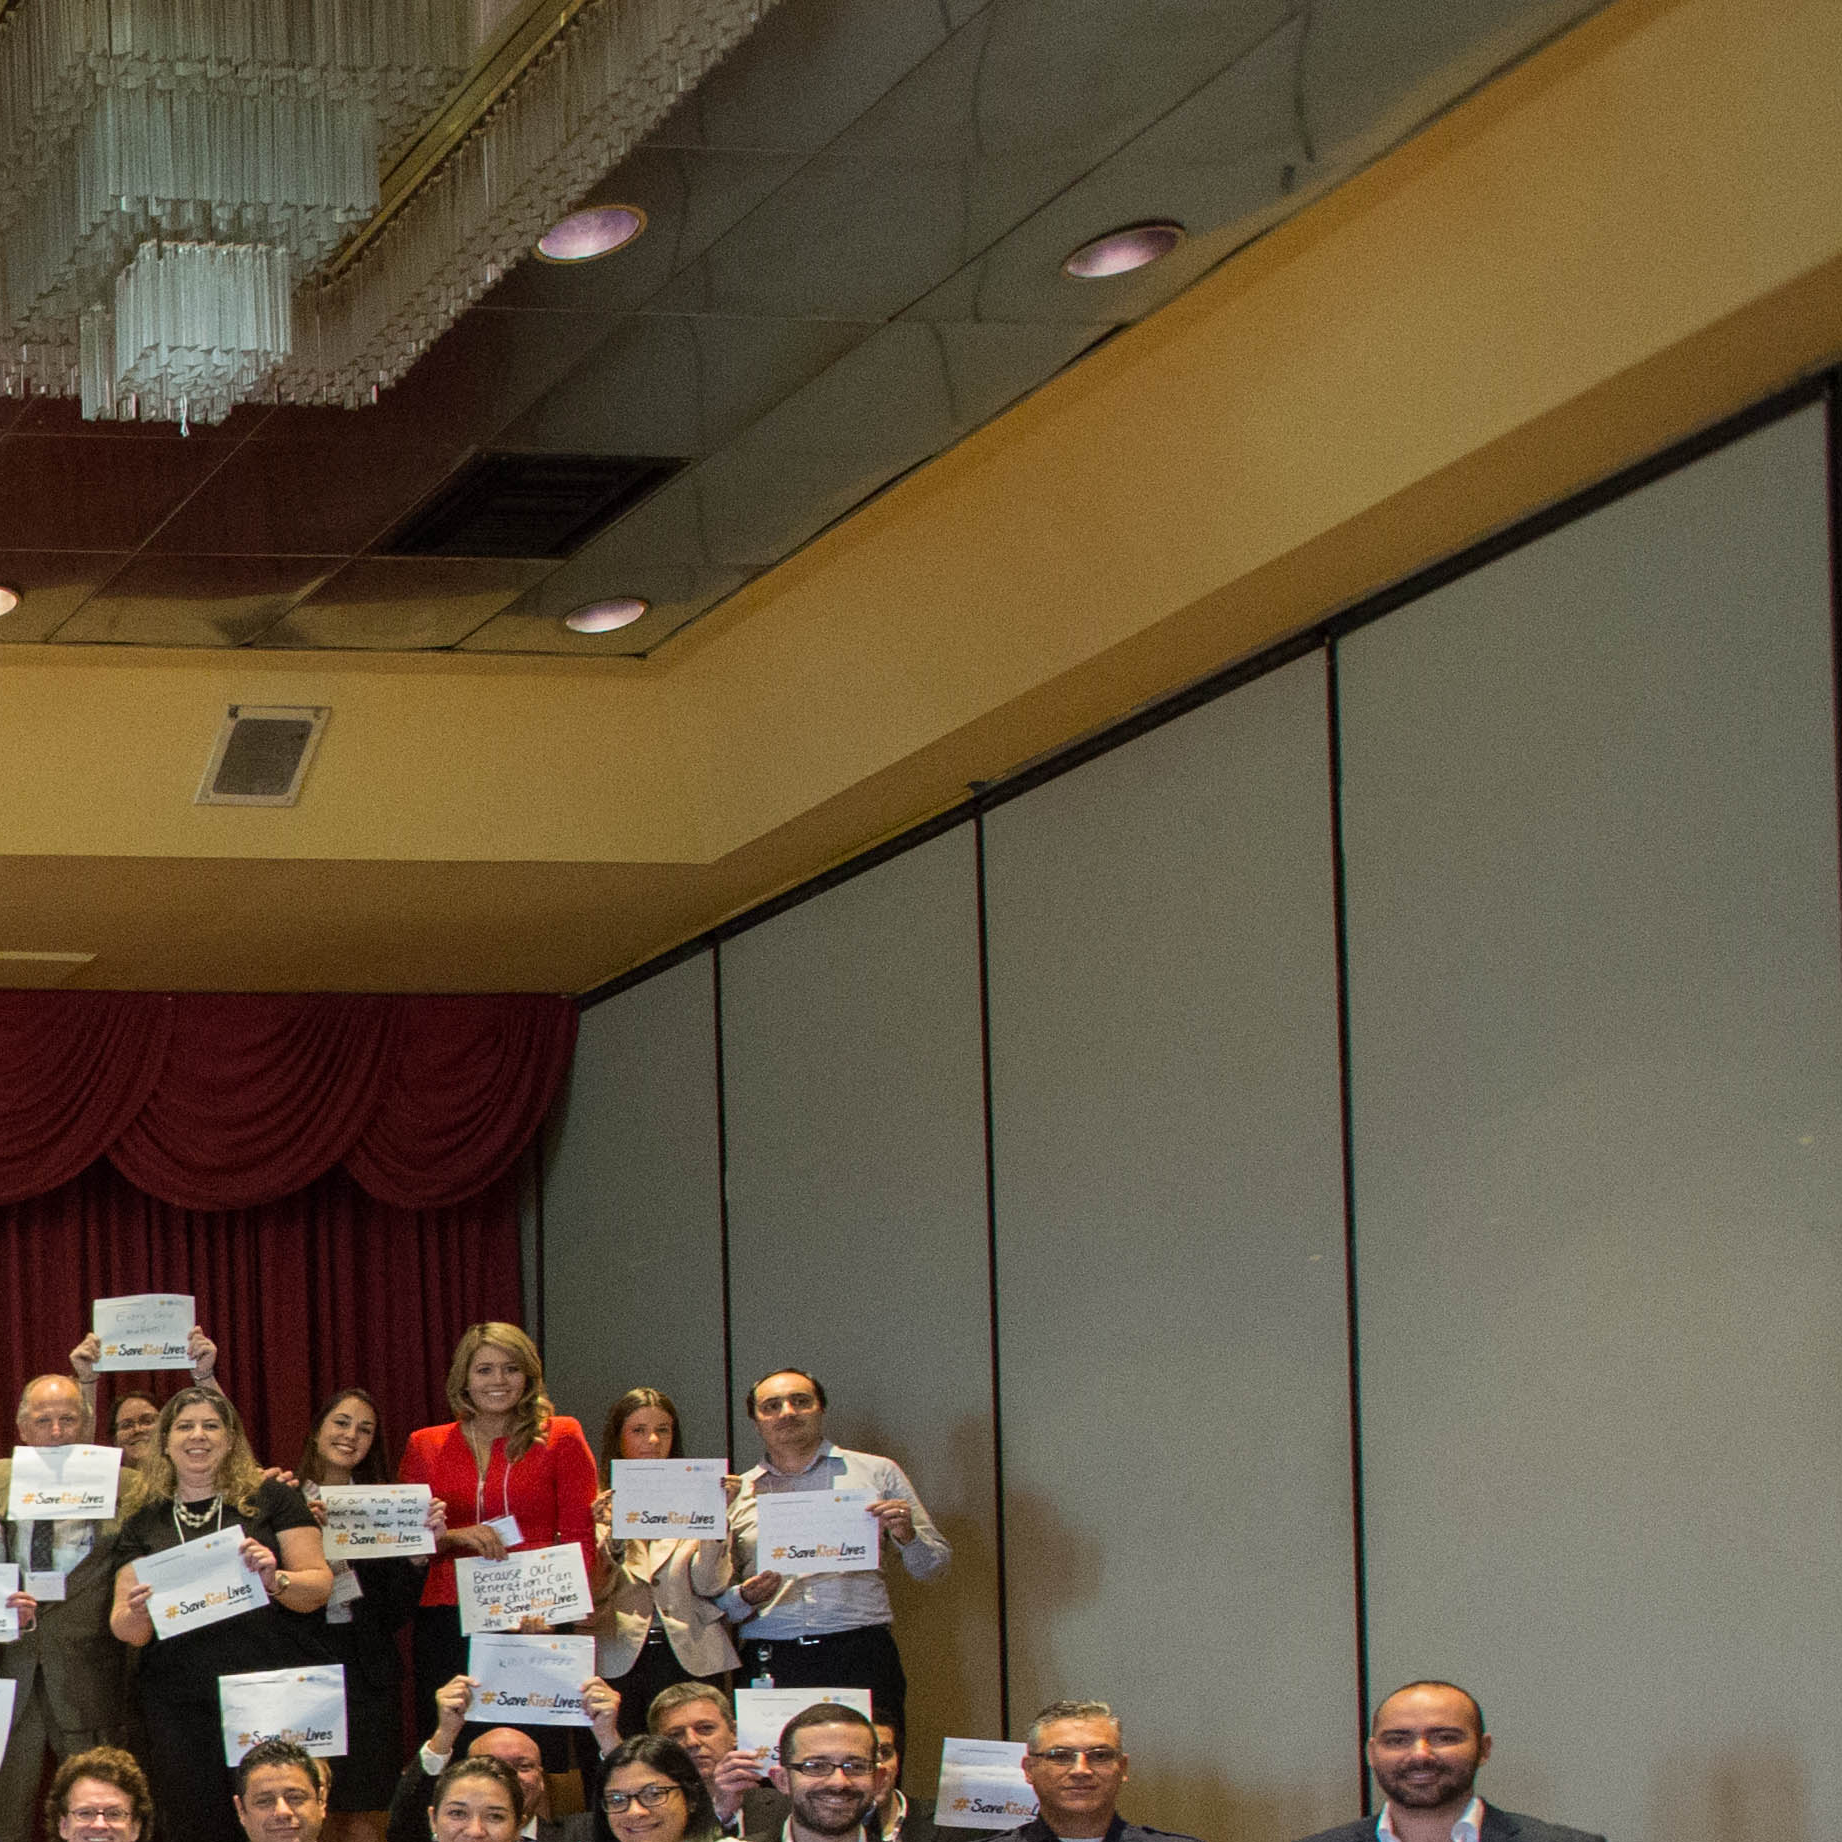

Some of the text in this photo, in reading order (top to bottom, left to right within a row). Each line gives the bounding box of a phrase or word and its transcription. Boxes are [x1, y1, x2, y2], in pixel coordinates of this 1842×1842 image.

[473, 1563, 555, 1584] Because our
[547, 1572, 572, 1584] can
